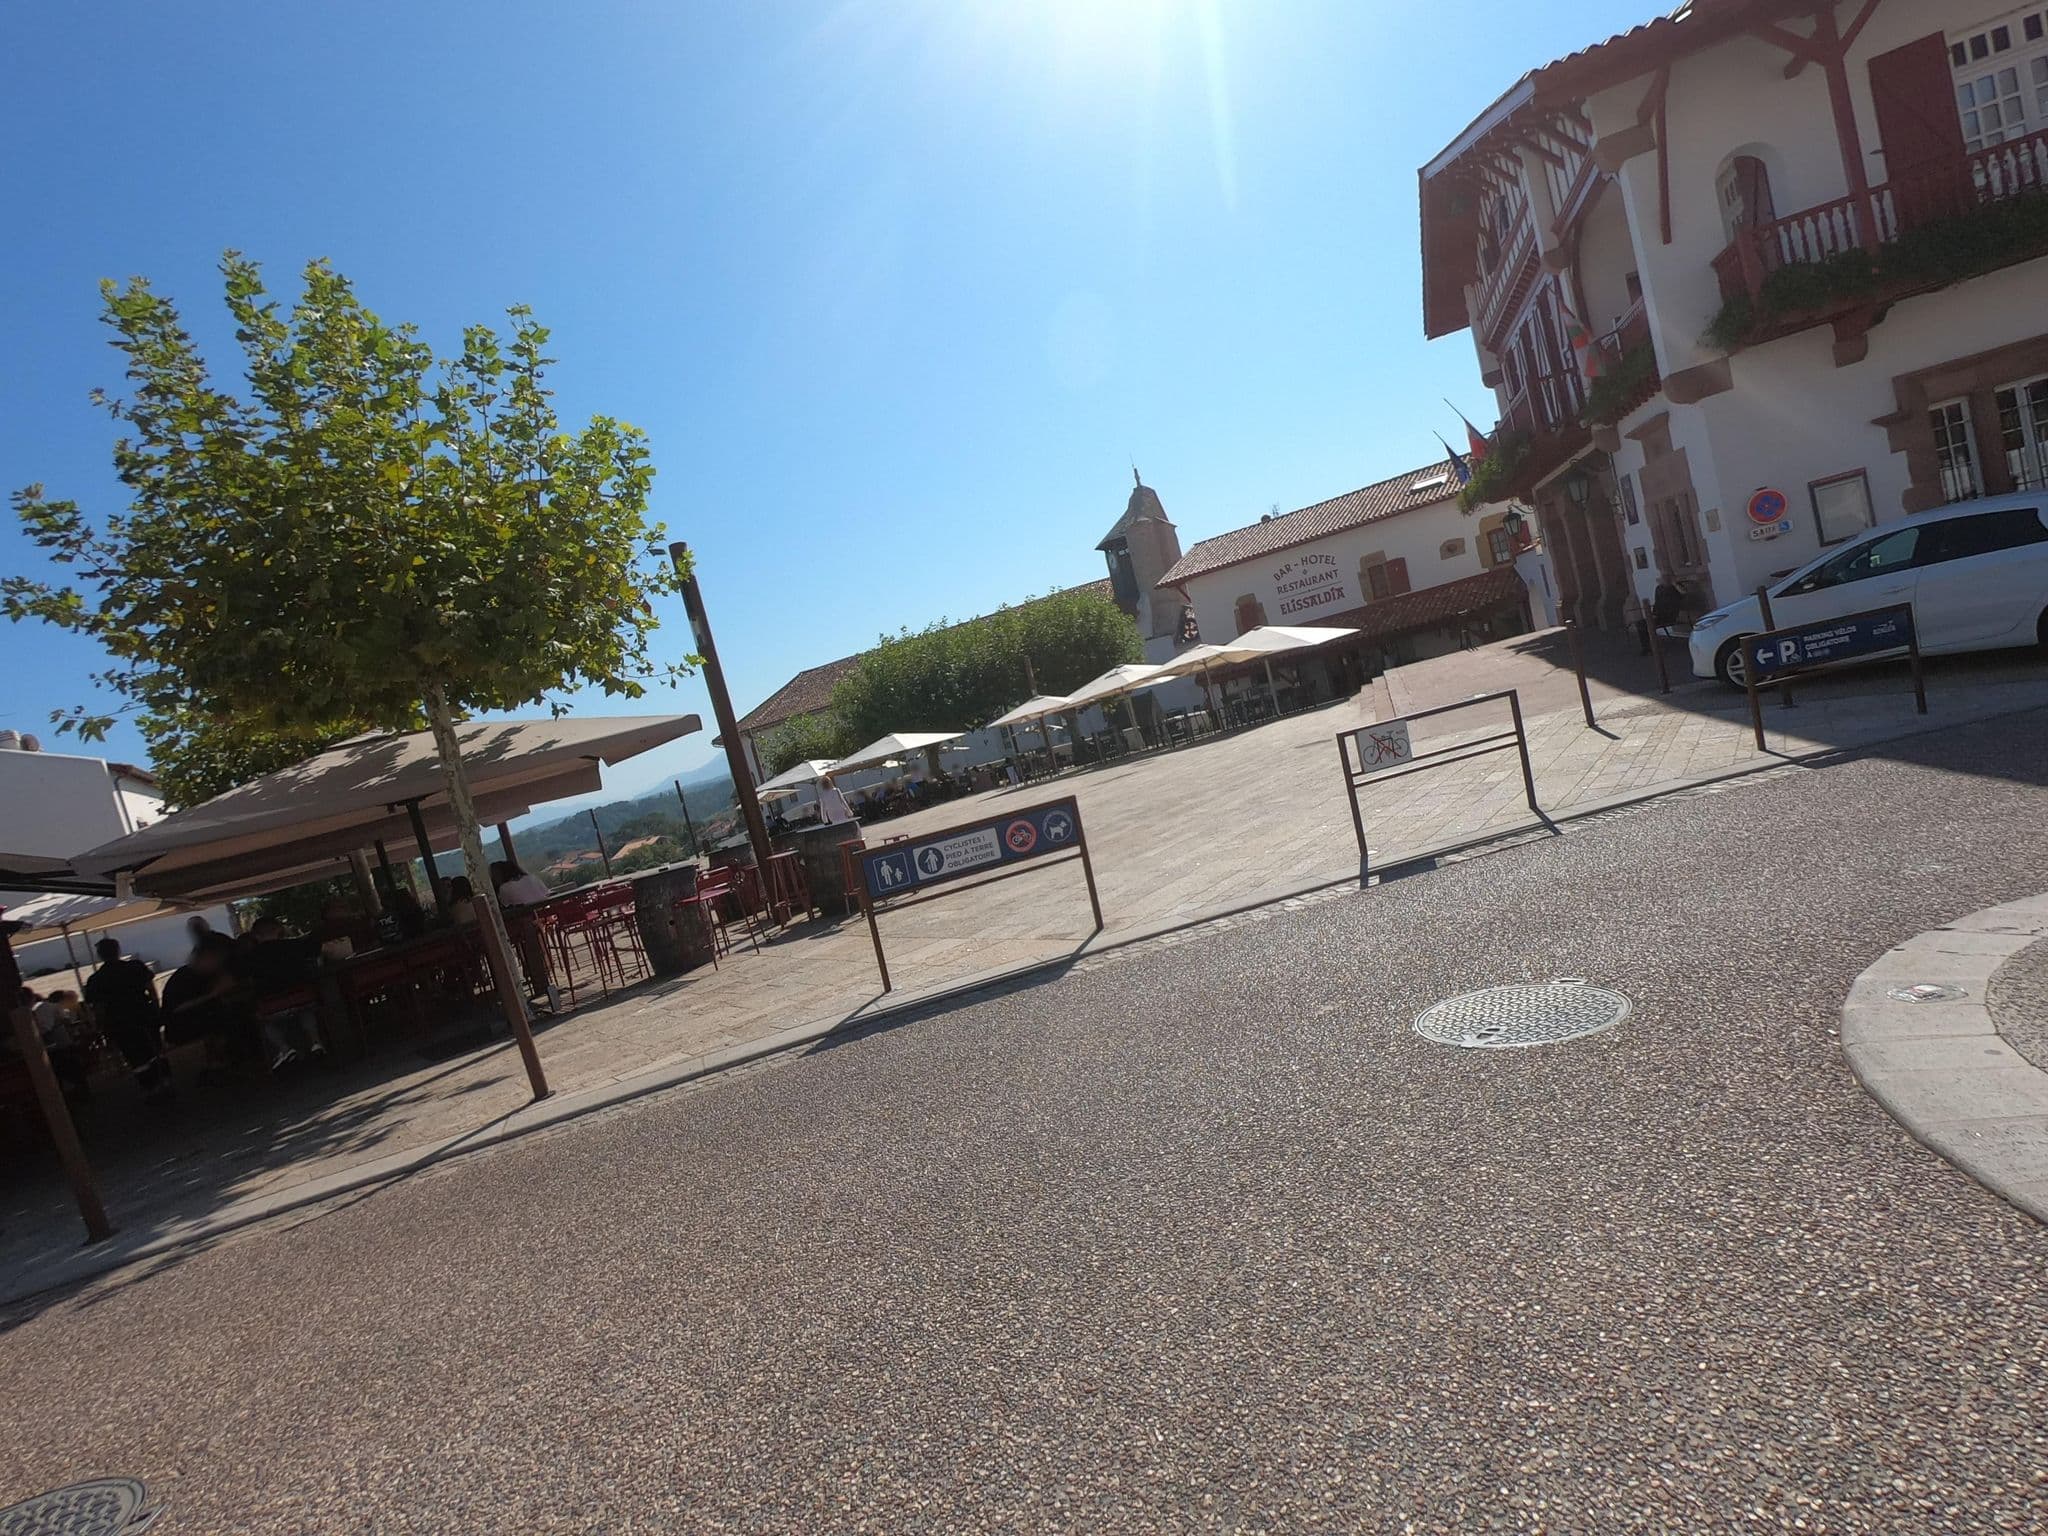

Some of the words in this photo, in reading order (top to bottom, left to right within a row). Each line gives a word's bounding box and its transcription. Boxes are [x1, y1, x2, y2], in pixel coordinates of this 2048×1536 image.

[1273, 563, 1293, 581] BAR
[1301, 554, 1337, 566] HOTEL
[1277, 569, 1339, 594] RESTAURANT
[1779, 640, 1796, 663] P
[943, 837, 981, 852] CYCLISTES
[945, 851, 962, 860] PIED
[971, 841, 994, 854] TERRE
[947, 850, 996, 869] OBLIGATOIRE
